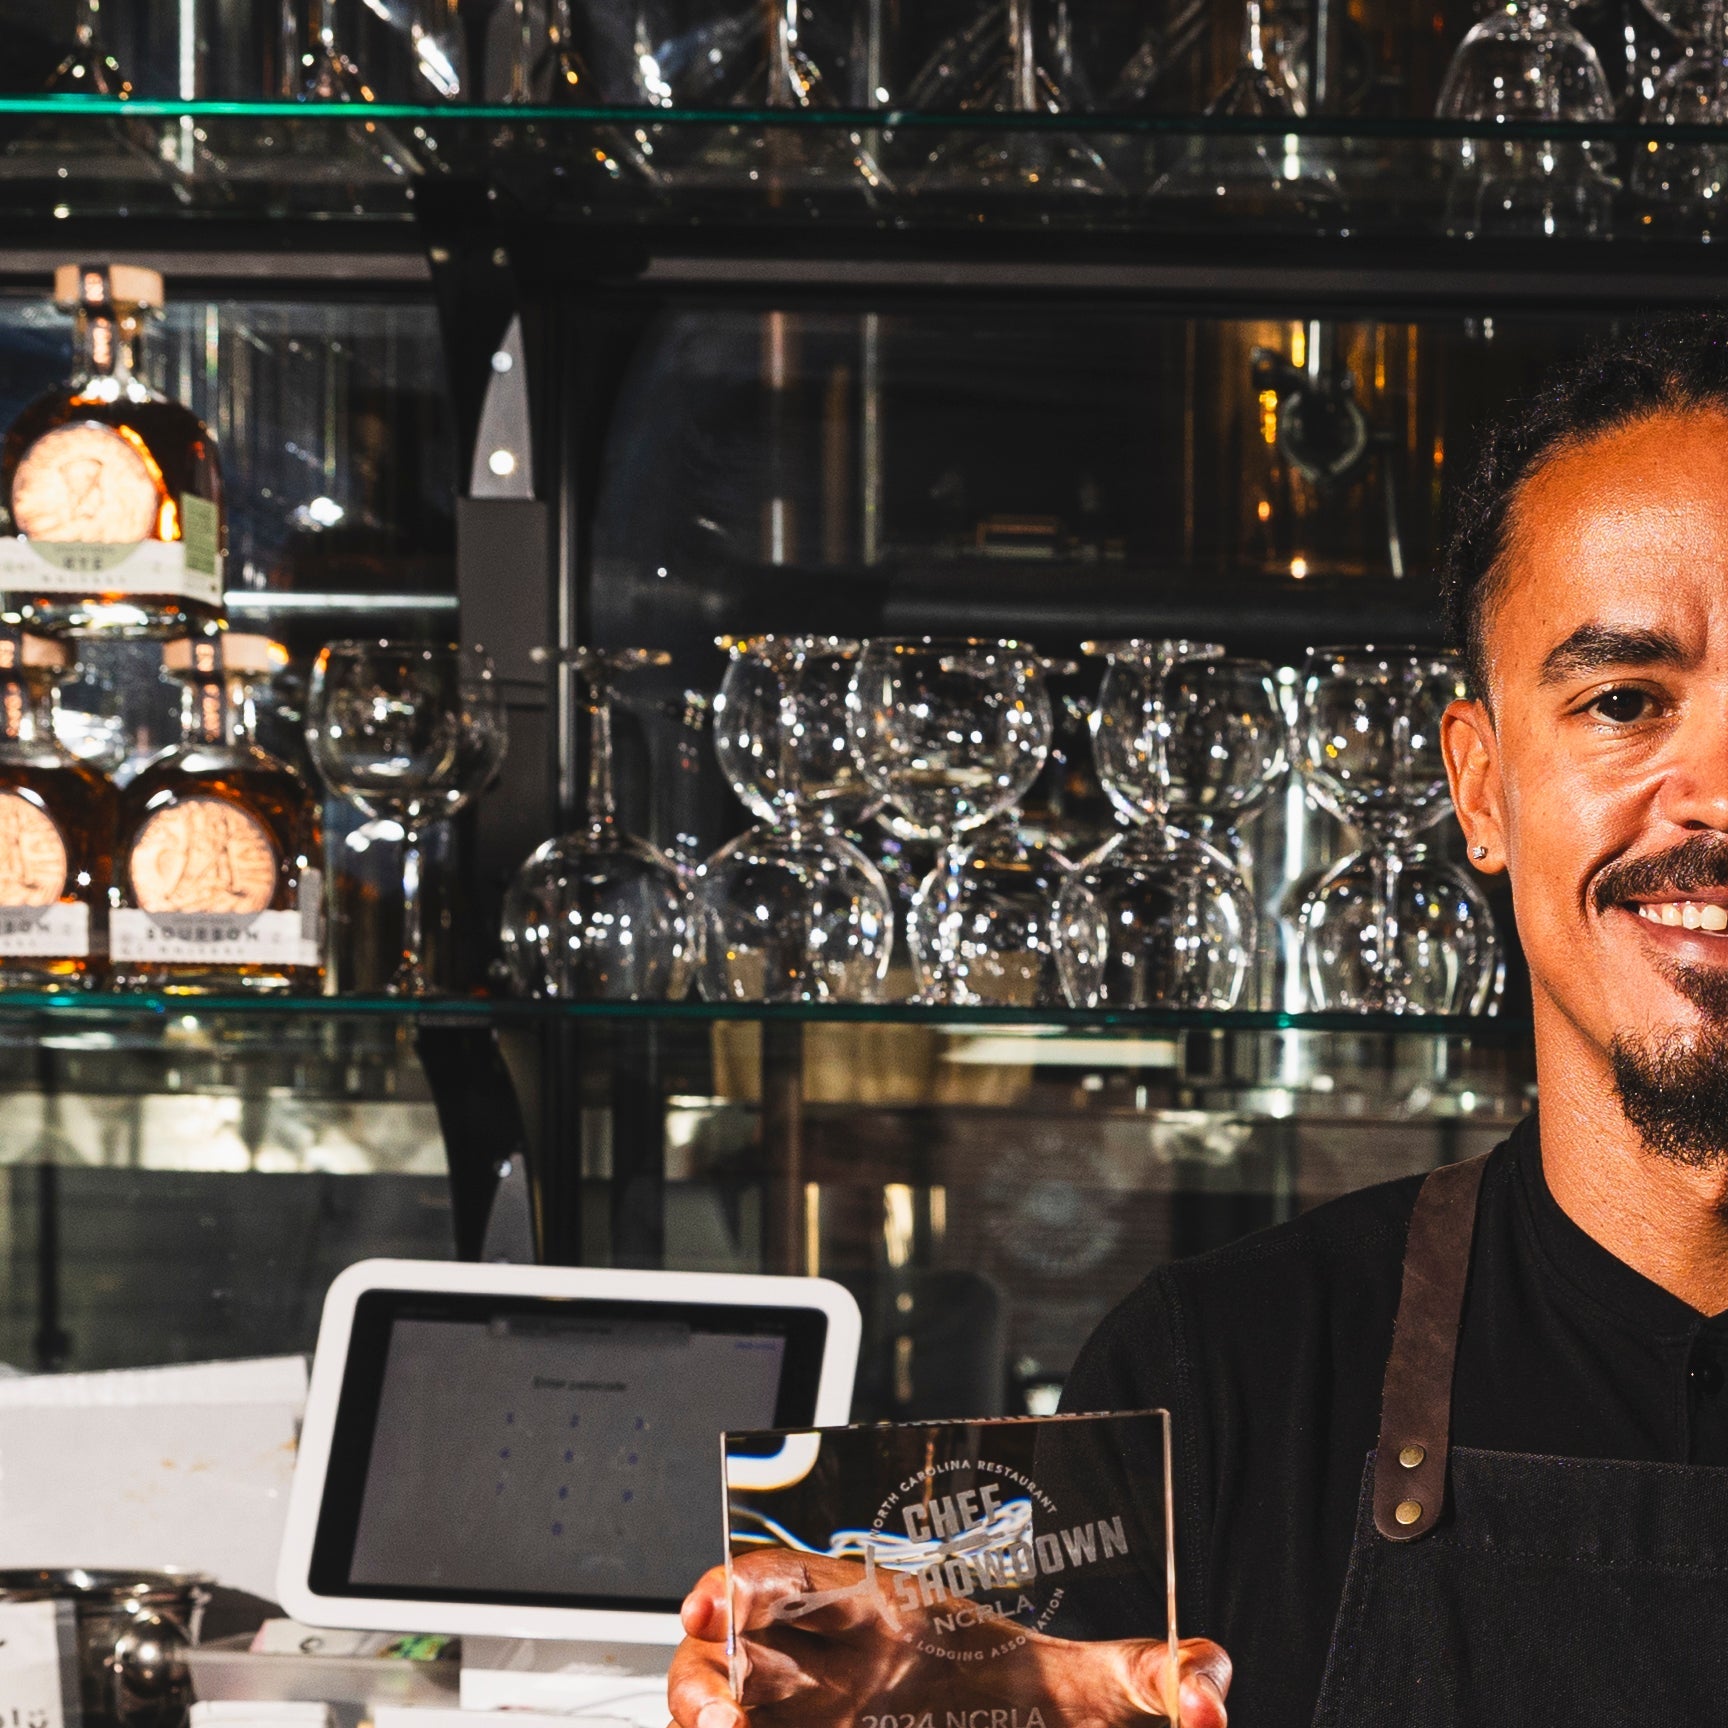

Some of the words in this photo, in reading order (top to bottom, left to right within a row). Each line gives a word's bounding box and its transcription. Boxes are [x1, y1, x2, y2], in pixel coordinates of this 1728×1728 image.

[870, 1492, 900, 1538] NORTH
[900, 1458, 971, 1493] CAROLINA
[977, 1459, 1057, 1516] RESTAURANT
[902, 1483, 1002, 1544] CHEF
[893, 1516, 1129, 1613] SHOWDOWN
[932, 1594, 1036, 1636] NCRLA
[916, 1640, 985, 1661] LODGING
